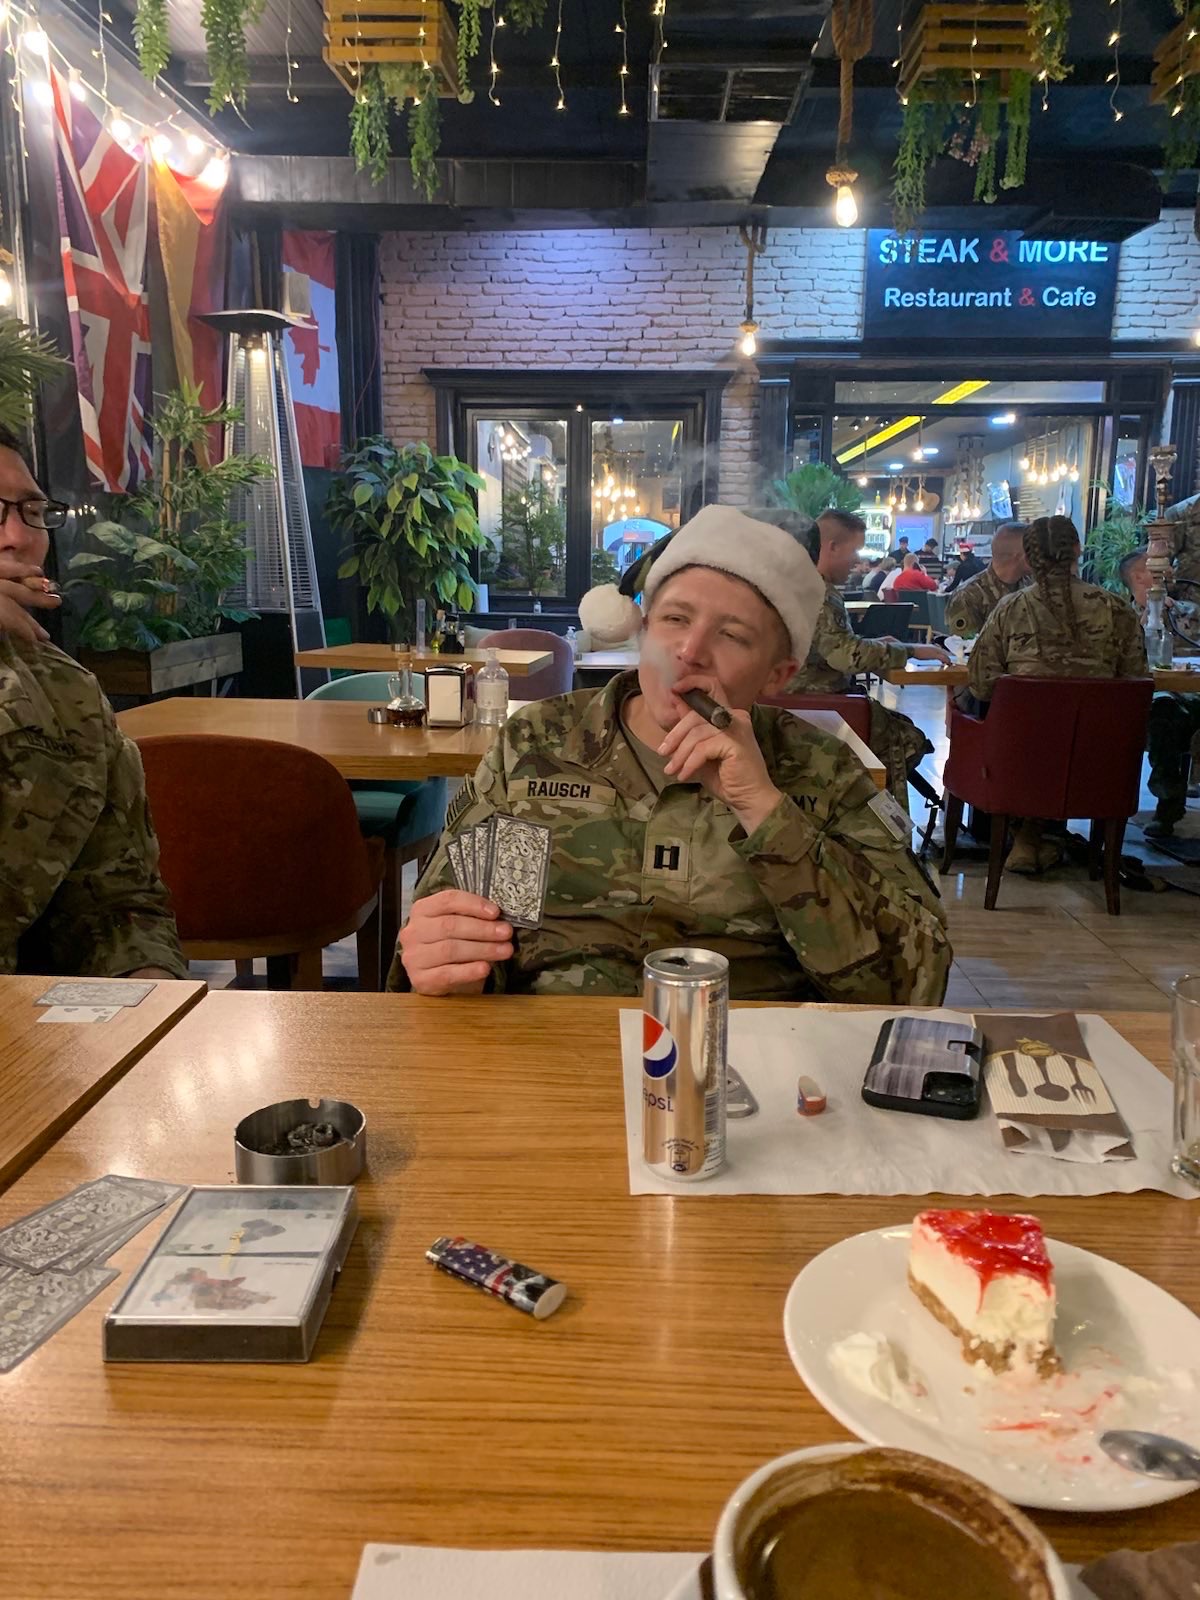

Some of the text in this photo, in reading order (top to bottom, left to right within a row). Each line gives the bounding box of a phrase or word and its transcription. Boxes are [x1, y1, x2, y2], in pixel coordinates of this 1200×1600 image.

[878, 237, 1109, 264] STEAK & MORE
[884, 285, 1097, 308] Restaurant & Cafe
[527, 780, 591, 799] RAUSCH
